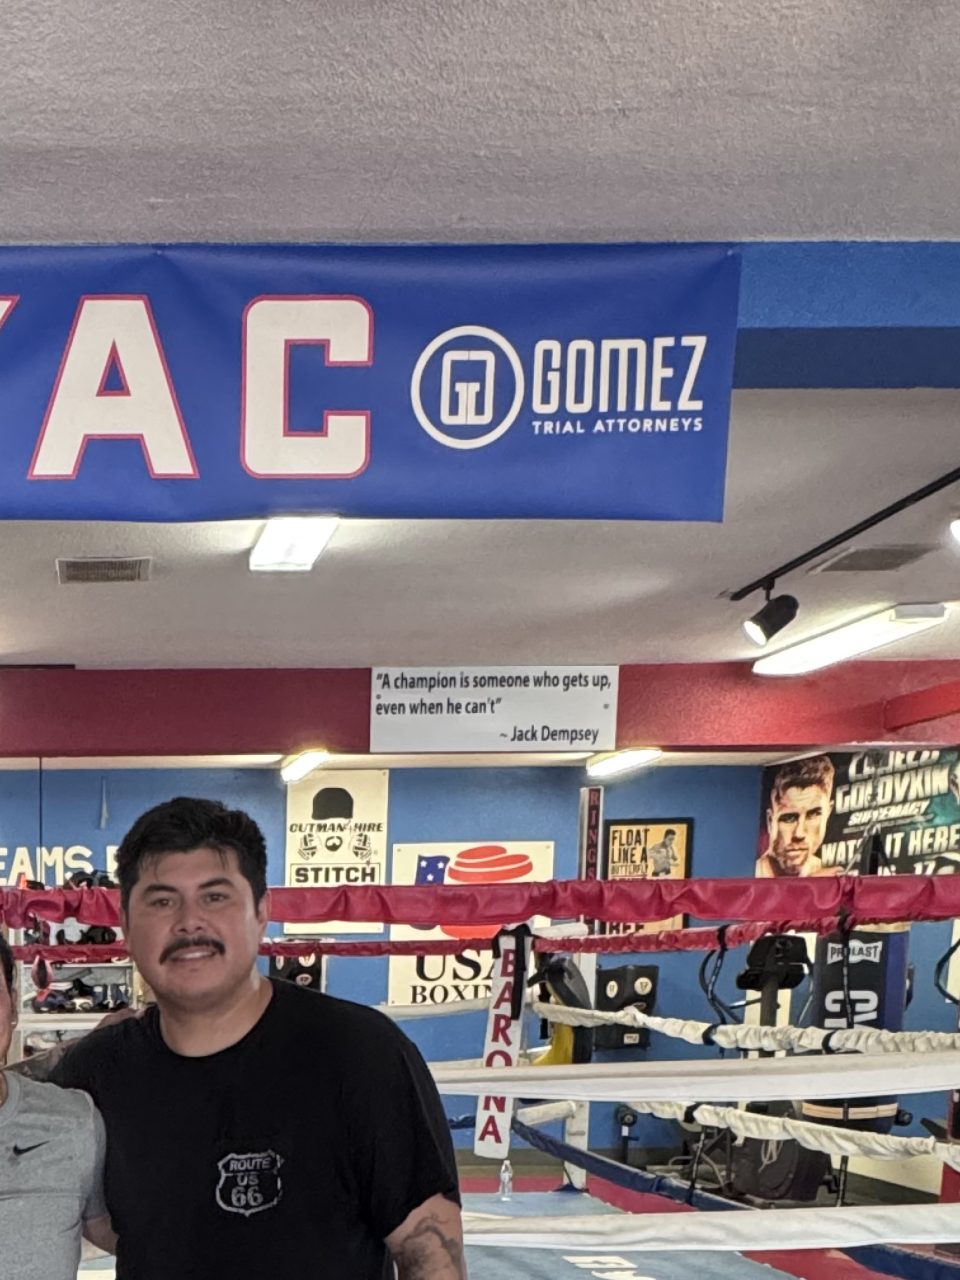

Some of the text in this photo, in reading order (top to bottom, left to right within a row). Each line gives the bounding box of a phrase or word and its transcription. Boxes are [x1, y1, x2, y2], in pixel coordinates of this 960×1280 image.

[532, 336, 707, 414] GOMEZ
[532, 417, 703, 435] TRIAL ATTORNEYS
[394, 672, 456, 692] champion
[460, 673, 470, 688] is
[473, 674, 530, 688] someone
[533, 672, 560, 687] who
[563, 674, 589, 691] gets
[592, 676, 611, 689] up,
[376, 700, 406, 715] even
[409, 698, 443, 714] when
[447, 698, 462, 714] he
[510, 726, 537, 742] Jack
[541, 725, 599, 744] Dempsey
[289, 822, 345, 833] CUTMAN
[354, 822, 384, 832] HIRE
[612, 829, 650, 846] FLOAT
[885, 831, 905, 858] IT
[611, 846, 648, 864] LIKE A
[295, 867, 376, 883] STITCH
[229, 1157, 272, 1171] ROUTE
[236, 1173, 259, 1187] US
[231, 1186, 263, 1206] 66
